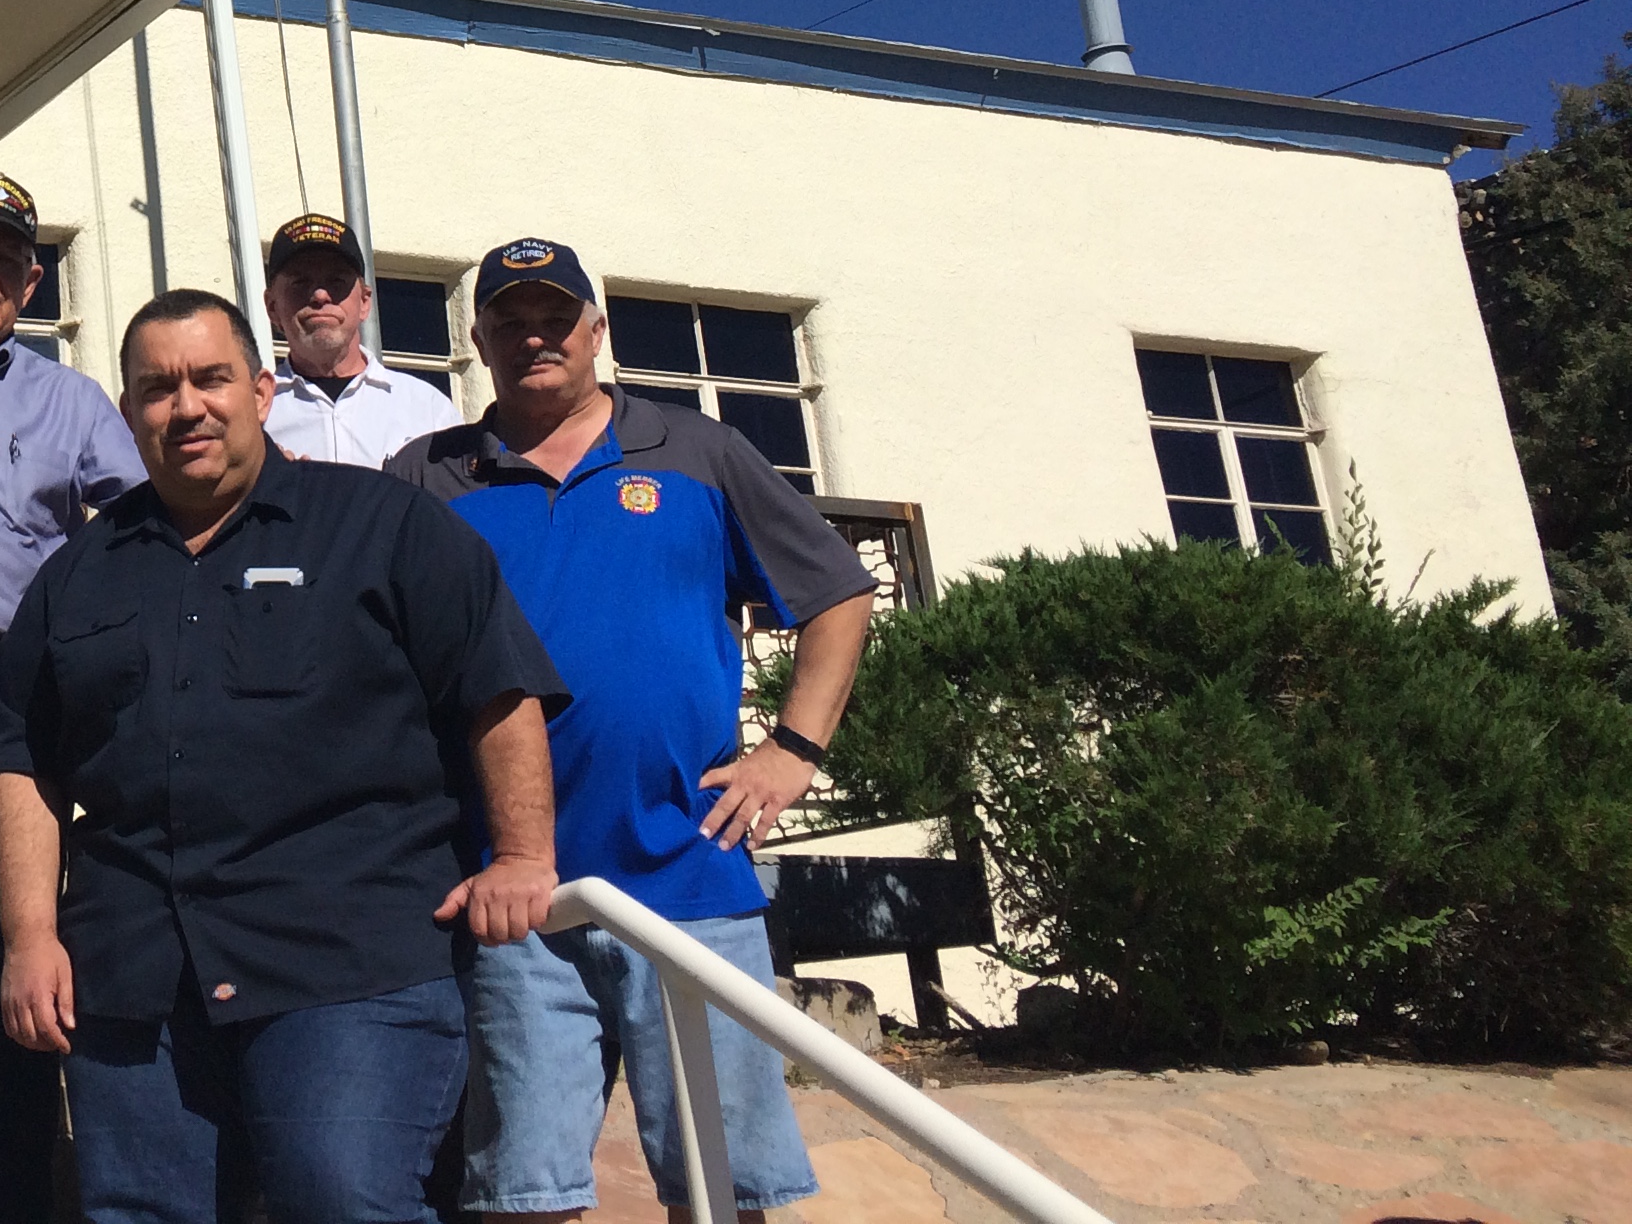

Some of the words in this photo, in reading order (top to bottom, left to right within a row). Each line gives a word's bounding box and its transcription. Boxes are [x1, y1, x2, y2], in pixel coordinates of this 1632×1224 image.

[306, 216, 346, 234] FREEDOM
[292, 232, 340, 245] VETERAN
[522, 240, 553, 252] NAVY
[510, 249, 546, 262] RETIRED
